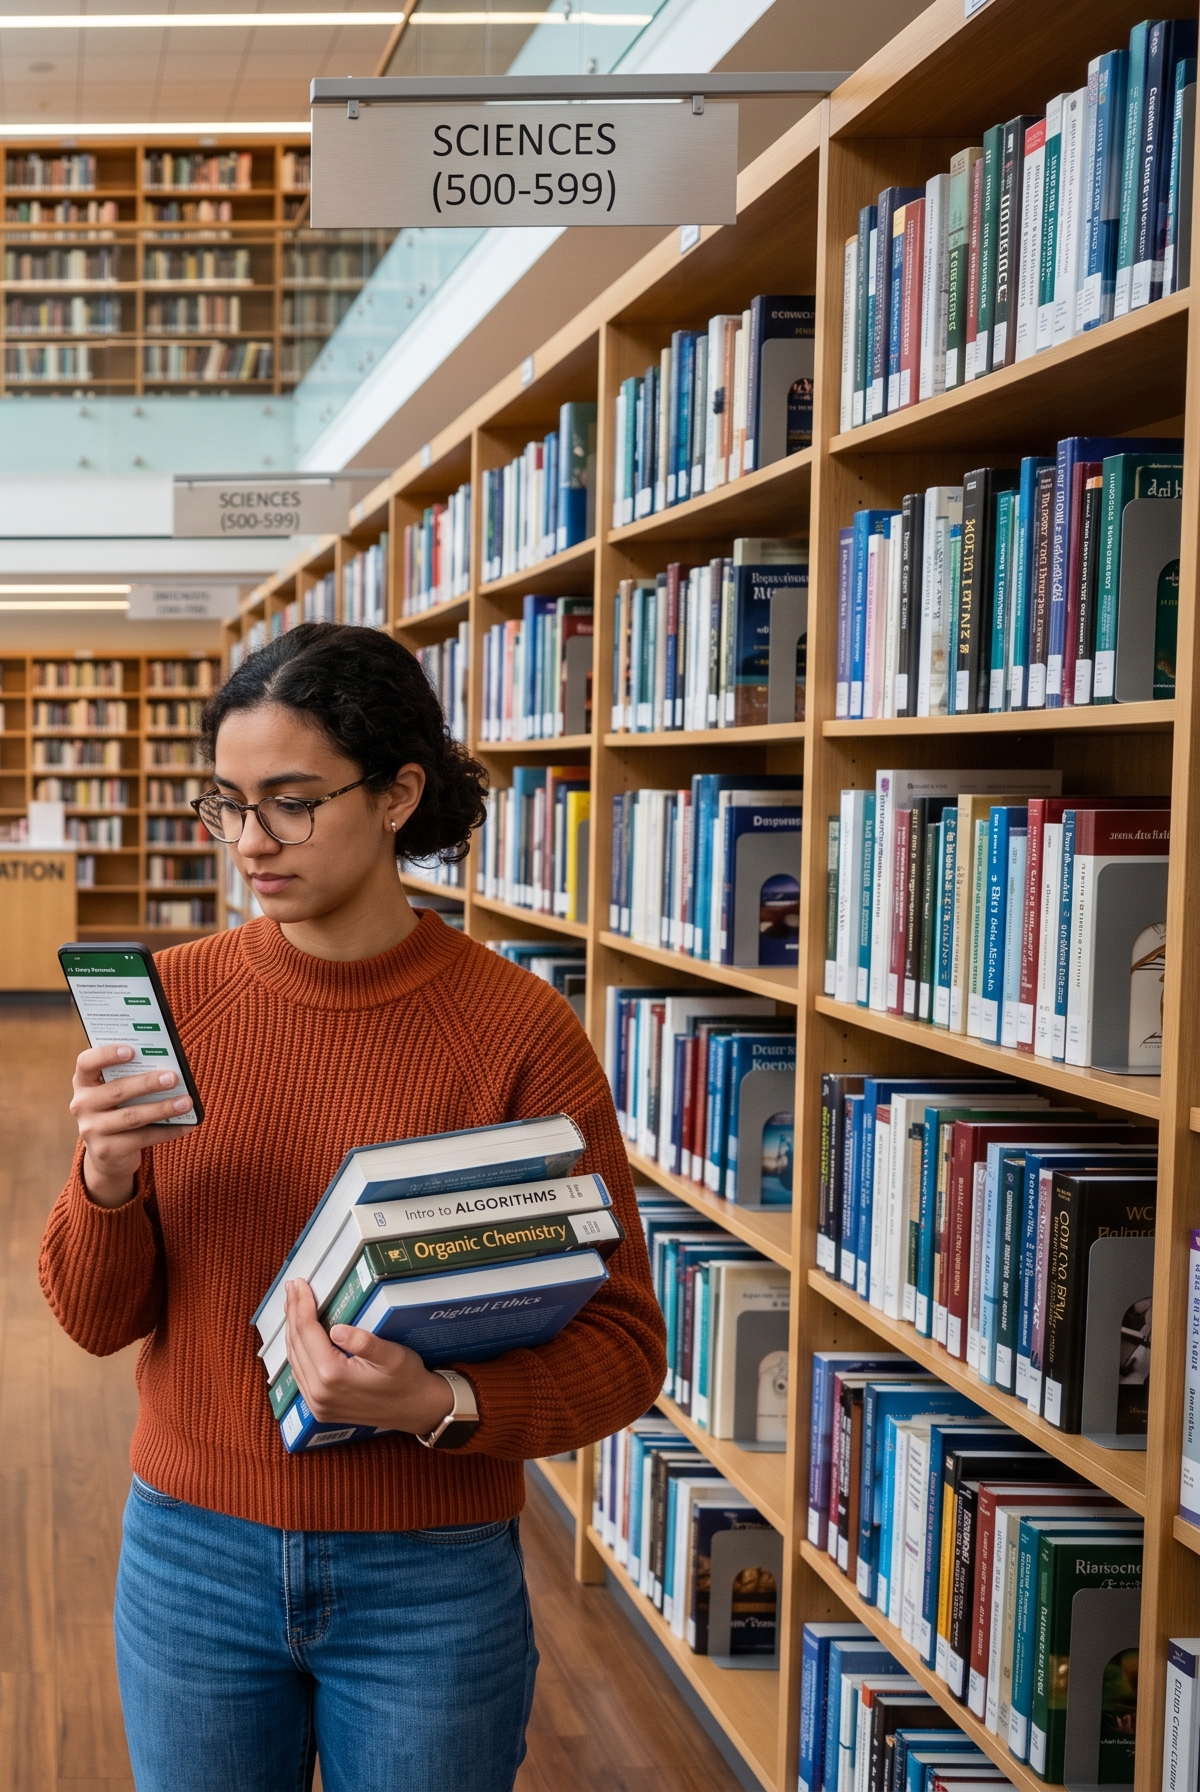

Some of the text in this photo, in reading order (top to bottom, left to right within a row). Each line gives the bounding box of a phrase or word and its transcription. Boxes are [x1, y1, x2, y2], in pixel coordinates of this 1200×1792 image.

[433, 123, 616, 157] SCIENCES
[433, 170, 616, 213] (500-599)
[219, 491, 302, 508] SCIENCES
[220, 512, 300, 532] (500-599)
[405, 1209, 435, 1221] Intro
[438, 1205, 452, 1216] to
[455, 1189, 557, 1214] ALGORITHMS
[414, 1235, 481, 1260] Organic
[482, 1224, 566, 1248] Chemistry
[429, 1296, 542, 1320] Digital Ethics
